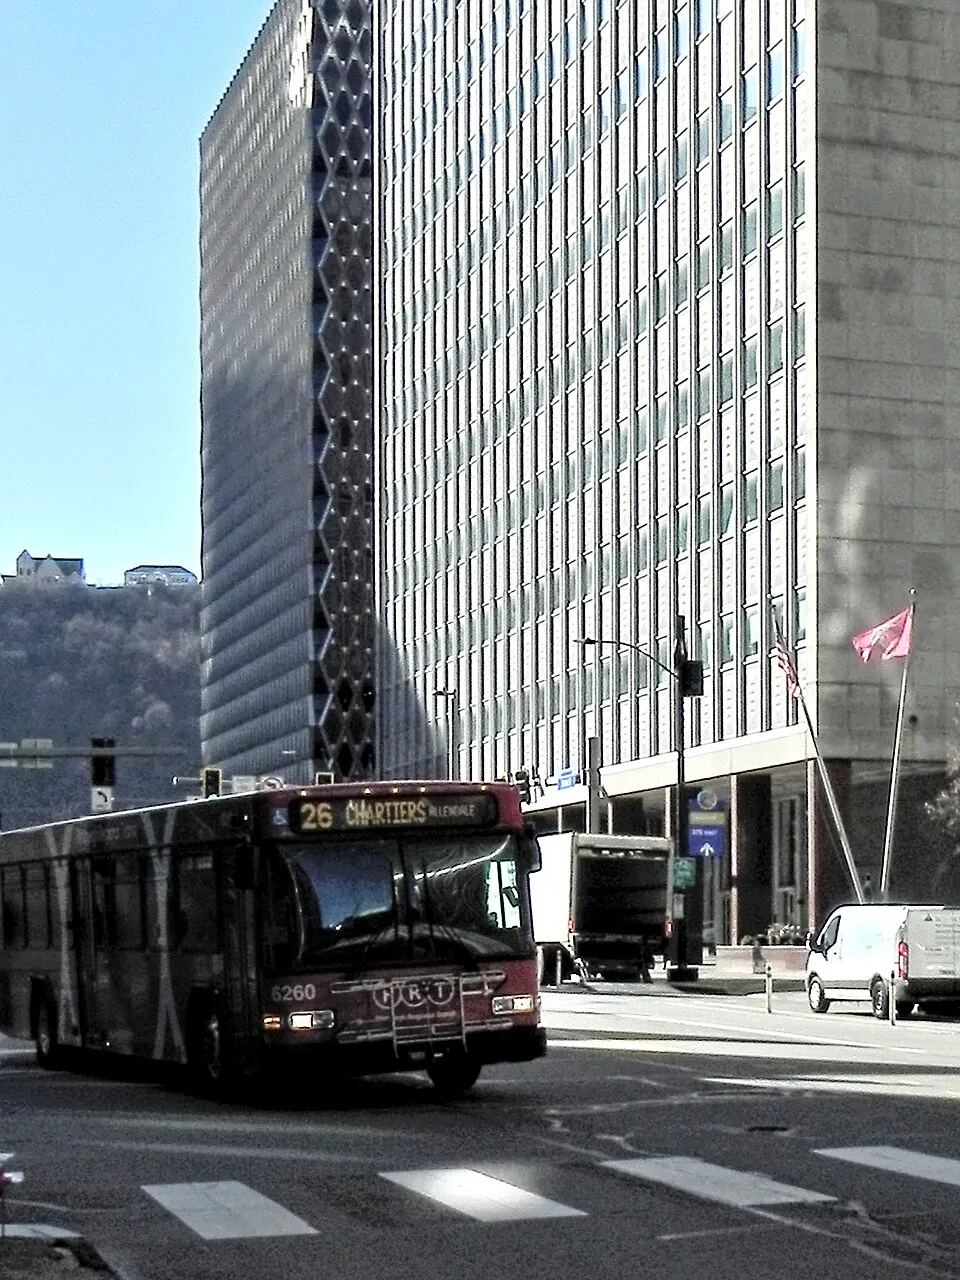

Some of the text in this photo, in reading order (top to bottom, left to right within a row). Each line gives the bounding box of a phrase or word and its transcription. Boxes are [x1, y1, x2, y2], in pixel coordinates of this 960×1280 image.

[301, 803, 333, 829] 26
[346, 800, 427, 825] CHARTIERS
[271, 983, 316, 1003] 6260
